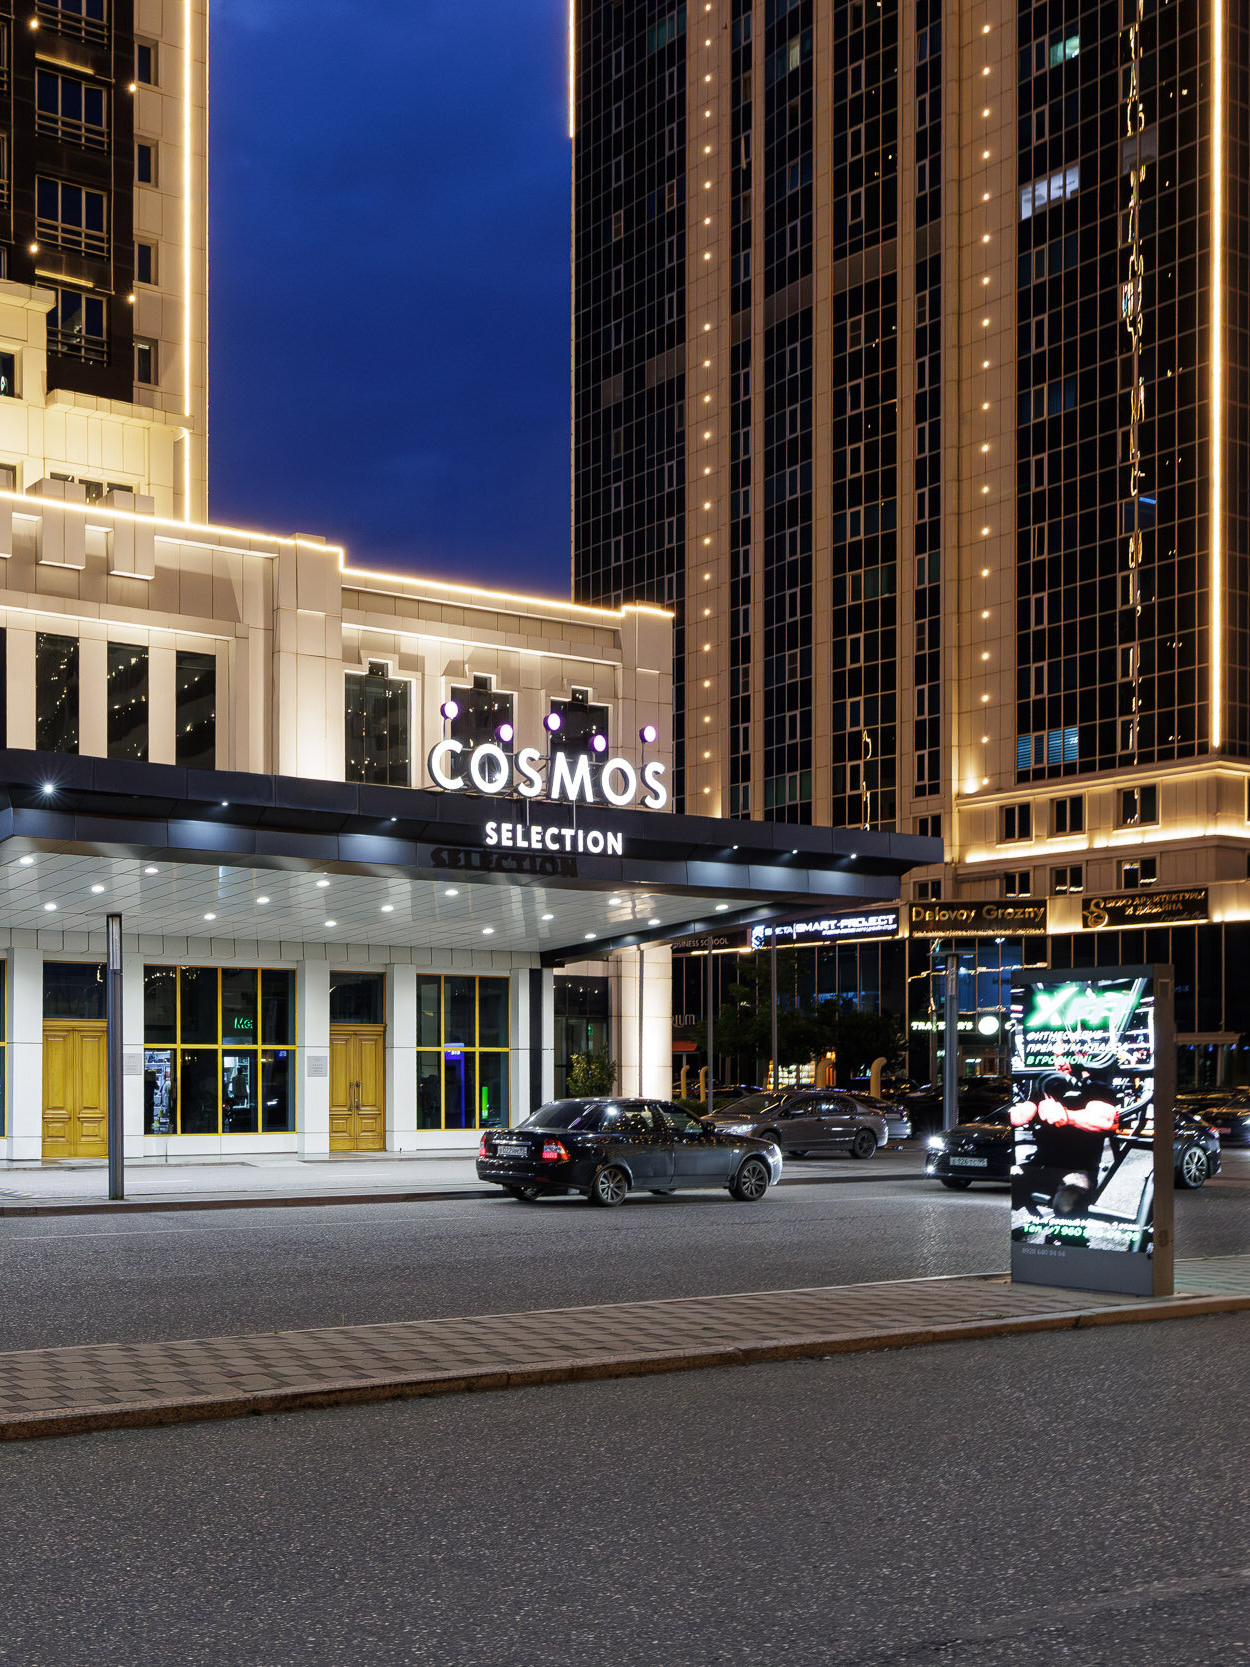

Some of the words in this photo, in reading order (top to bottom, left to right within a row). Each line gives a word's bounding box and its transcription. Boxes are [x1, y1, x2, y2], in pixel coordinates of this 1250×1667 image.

[427, 739, 667, 809] COSMOS
[485, 821, 623, 856] SELECTION
[912, 906, 976, 923] Delovoy
[982, 905, 1045, 921] Grozny
